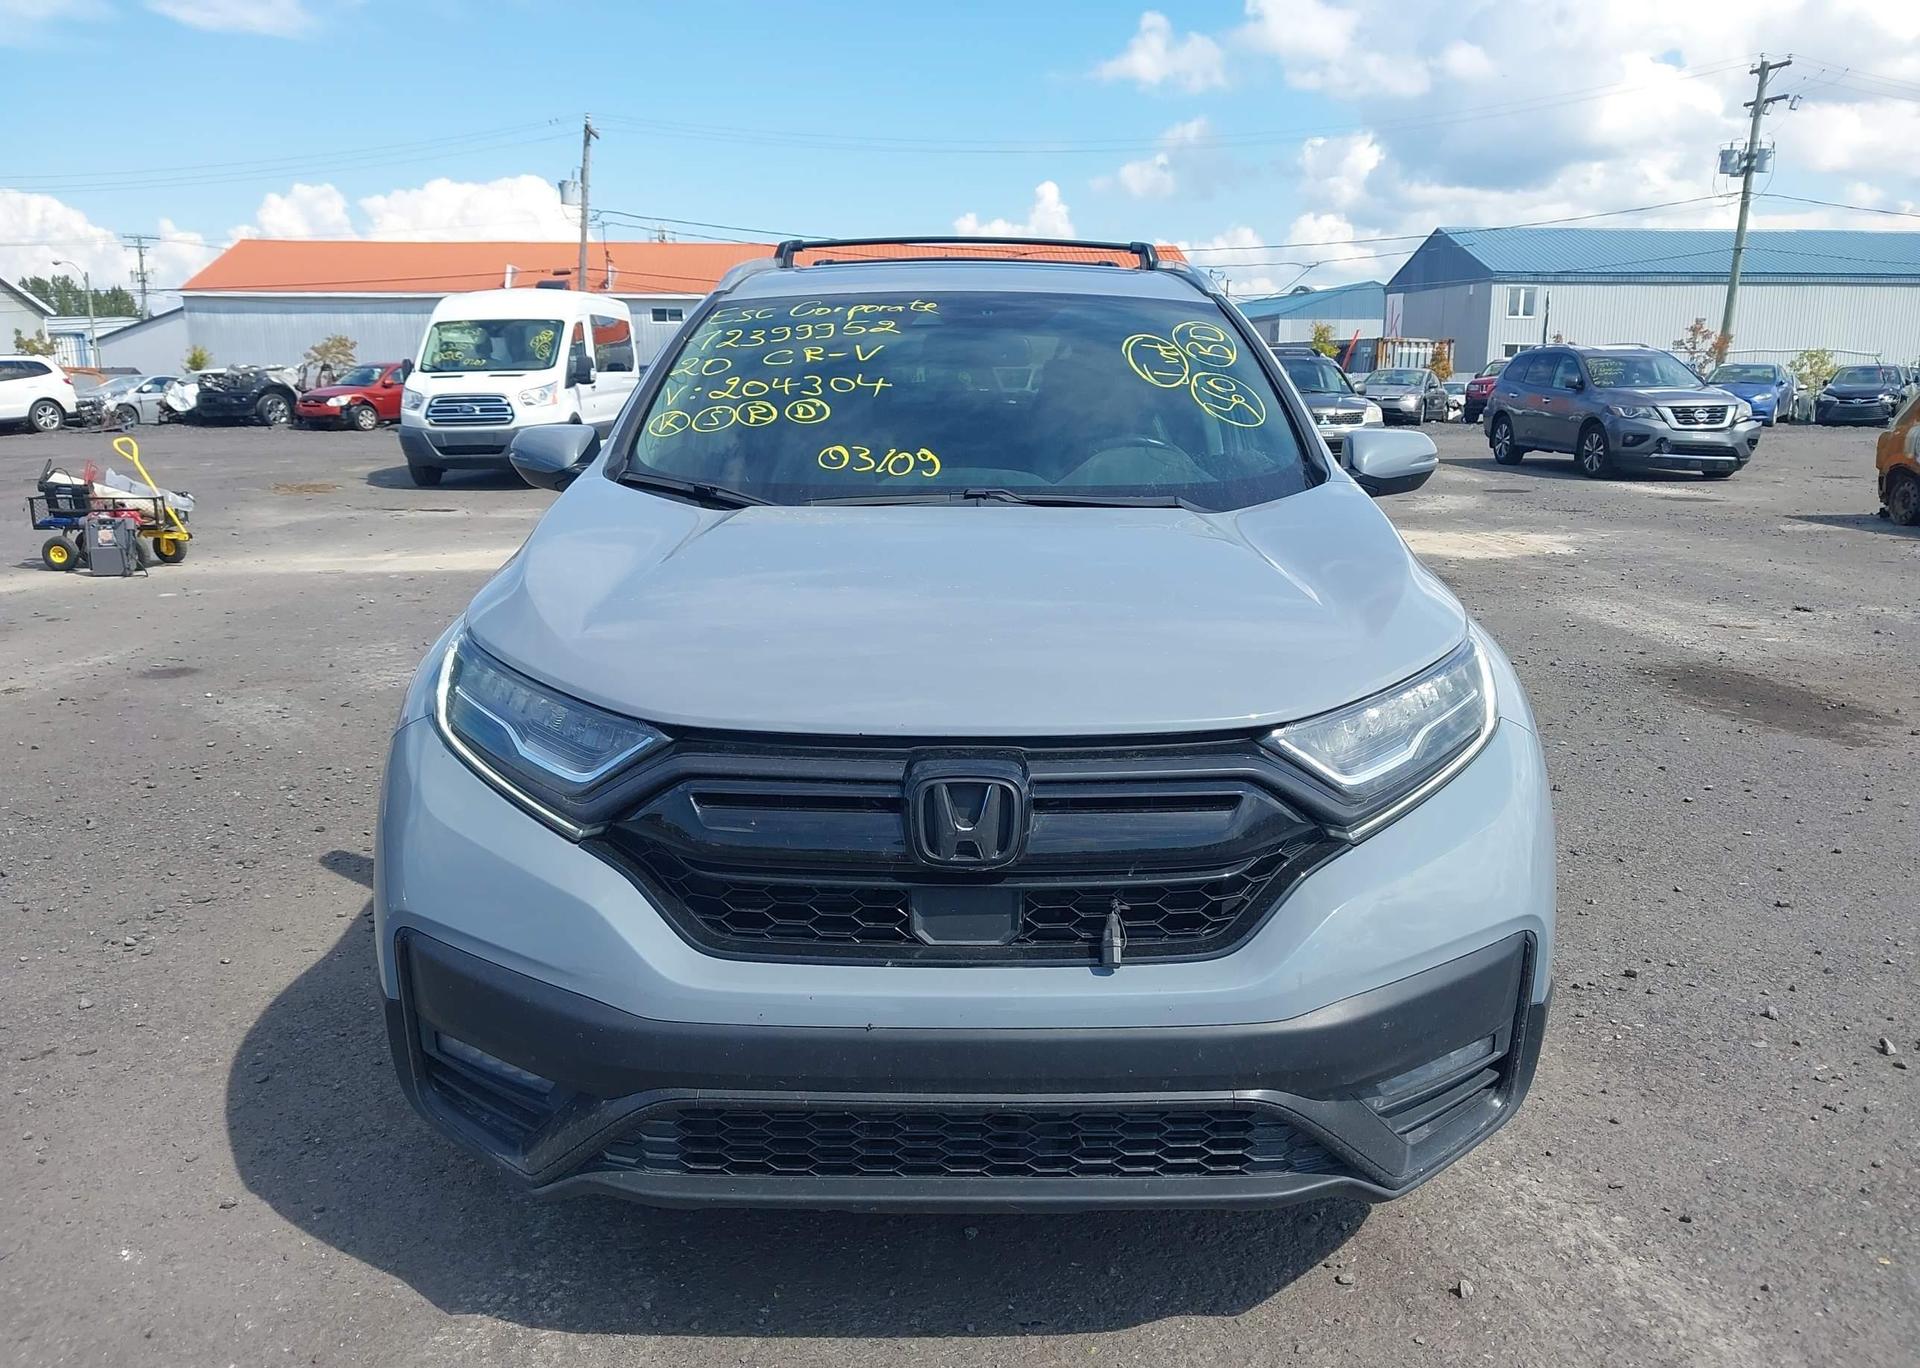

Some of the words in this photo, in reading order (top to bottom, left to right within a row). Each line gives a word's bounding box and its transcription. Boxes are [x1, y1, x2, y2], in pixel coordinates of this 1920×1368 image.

[789, 299, 941, 321] Corporate
[687, 320, 902, 351] 12399952
[669, 357, 732, 376] 20
[762, 344, 886, 366] CR-V
[708, 373, 894, 400] 204304
[817, 445, 942, 477] 03/09
